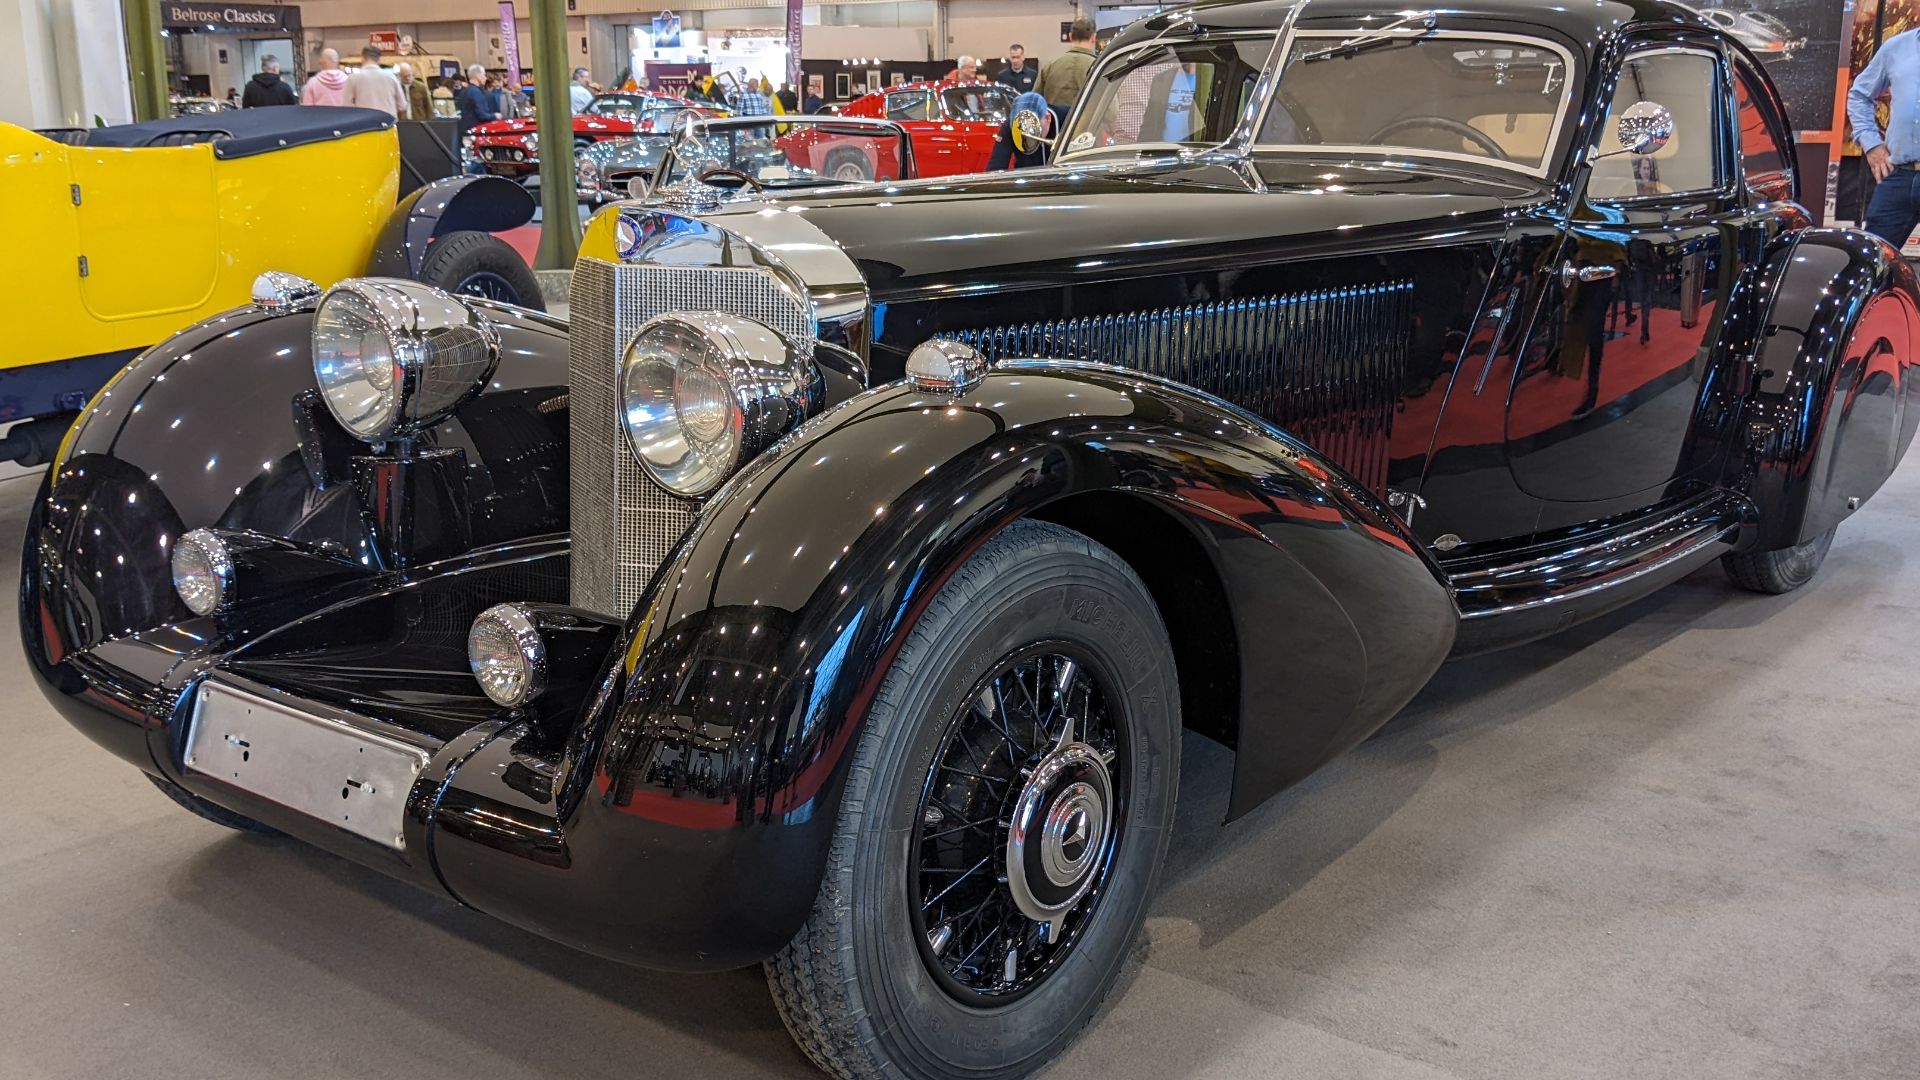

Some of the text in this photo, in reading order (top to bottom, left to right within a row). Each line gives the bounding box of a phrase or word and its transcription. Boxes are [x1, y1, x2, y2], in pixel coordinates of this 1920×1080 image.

[172, 8, 276, 23] Belrose Classics
[1070, 600, 1146, 671] MICHELIN
